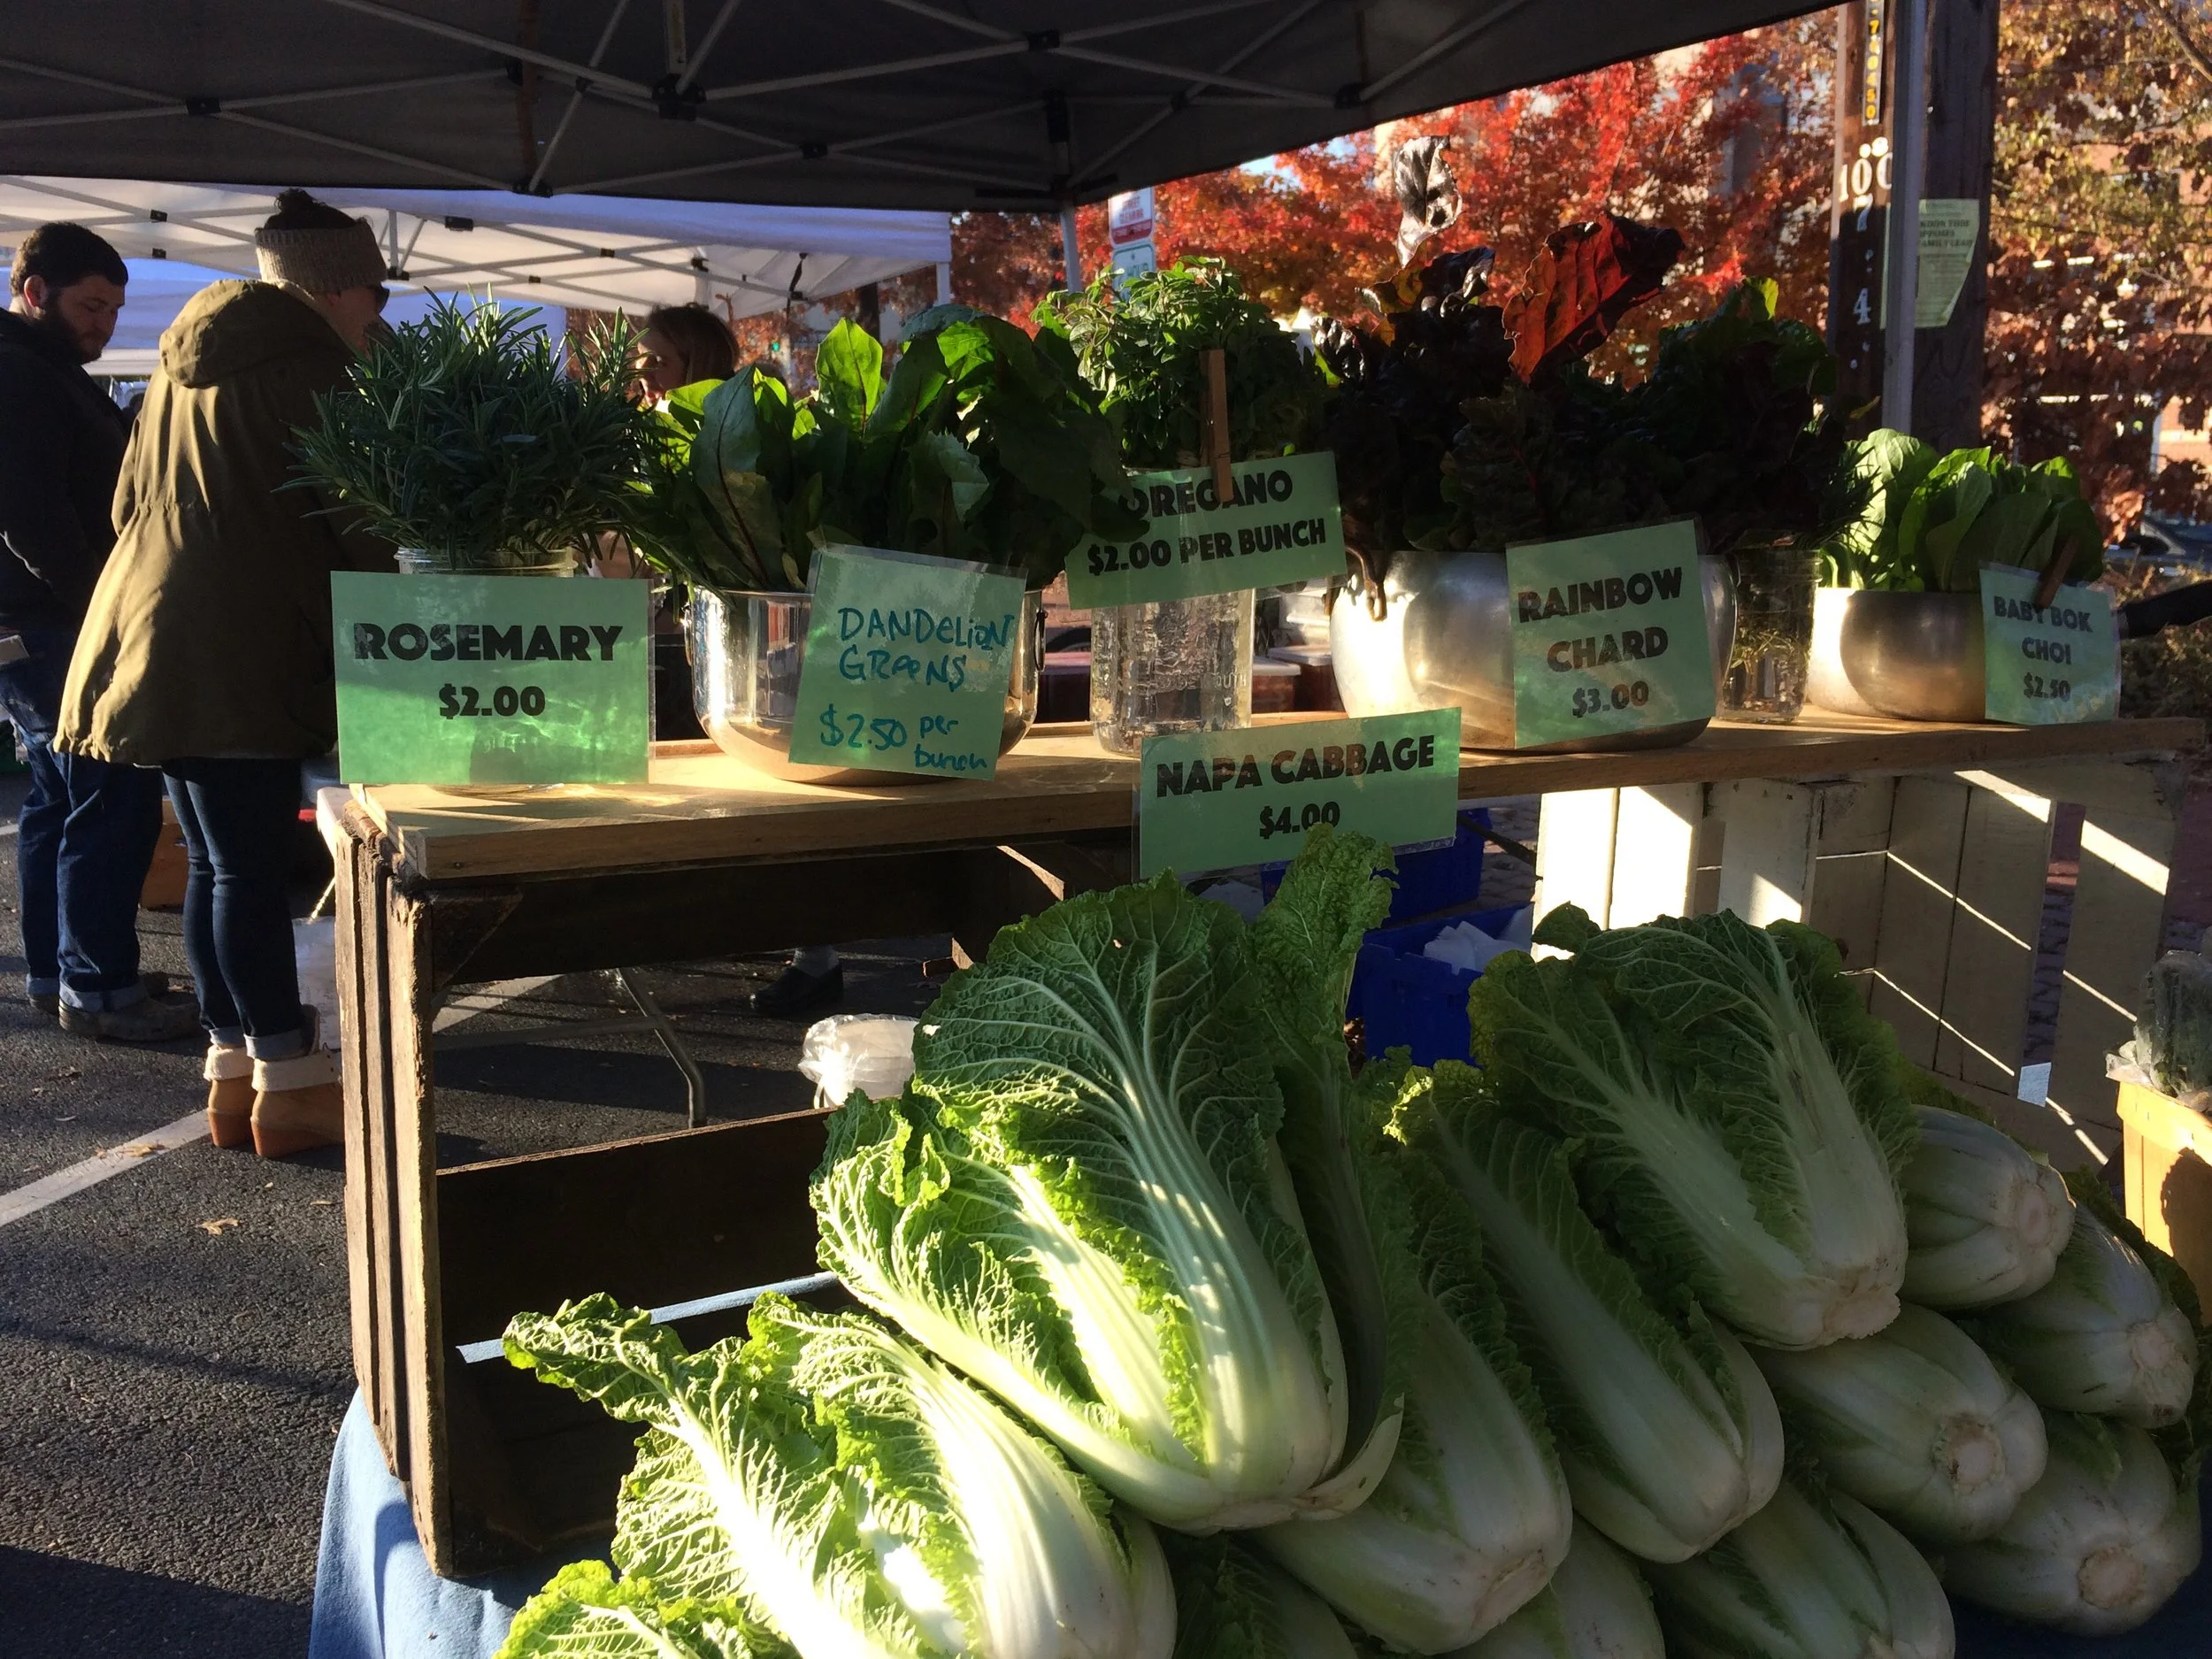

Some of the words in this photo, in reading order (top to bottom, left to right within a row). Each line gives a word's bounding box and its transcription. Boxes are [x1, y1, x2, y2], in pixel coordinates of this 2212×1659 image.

[1087, 541, 1171, 575] $2.00
[1179, 532, 1233, 564] PER
[1238, 518, 1325, 556] BUNCH
[1517, 567, 1682, 623] RAINBOW
[1993, 595, 2045, 624] BABY
[2050, 605, 2093, 633] BOK
[354, 623, 623, 661] ROSEMARY
[1547, 626, 1669, 672] CHARD
[2022, 637, 2072, 664] CHOI
[439, 683, 545, 718] $2.00
[1572, 680, 1649, 718] $3.00
[2024, 672, 2071, 702] $2.50
[820, 703, 907, 750] $2.50
[920, 715, 958, 739] per
[914, 744, 987, 772] bunch
[1156, 754, 1263, 797] NAPA
[1271, 735, 1435, 784] CABBAGE
[1260, 802, 1340, 840] $4.00
